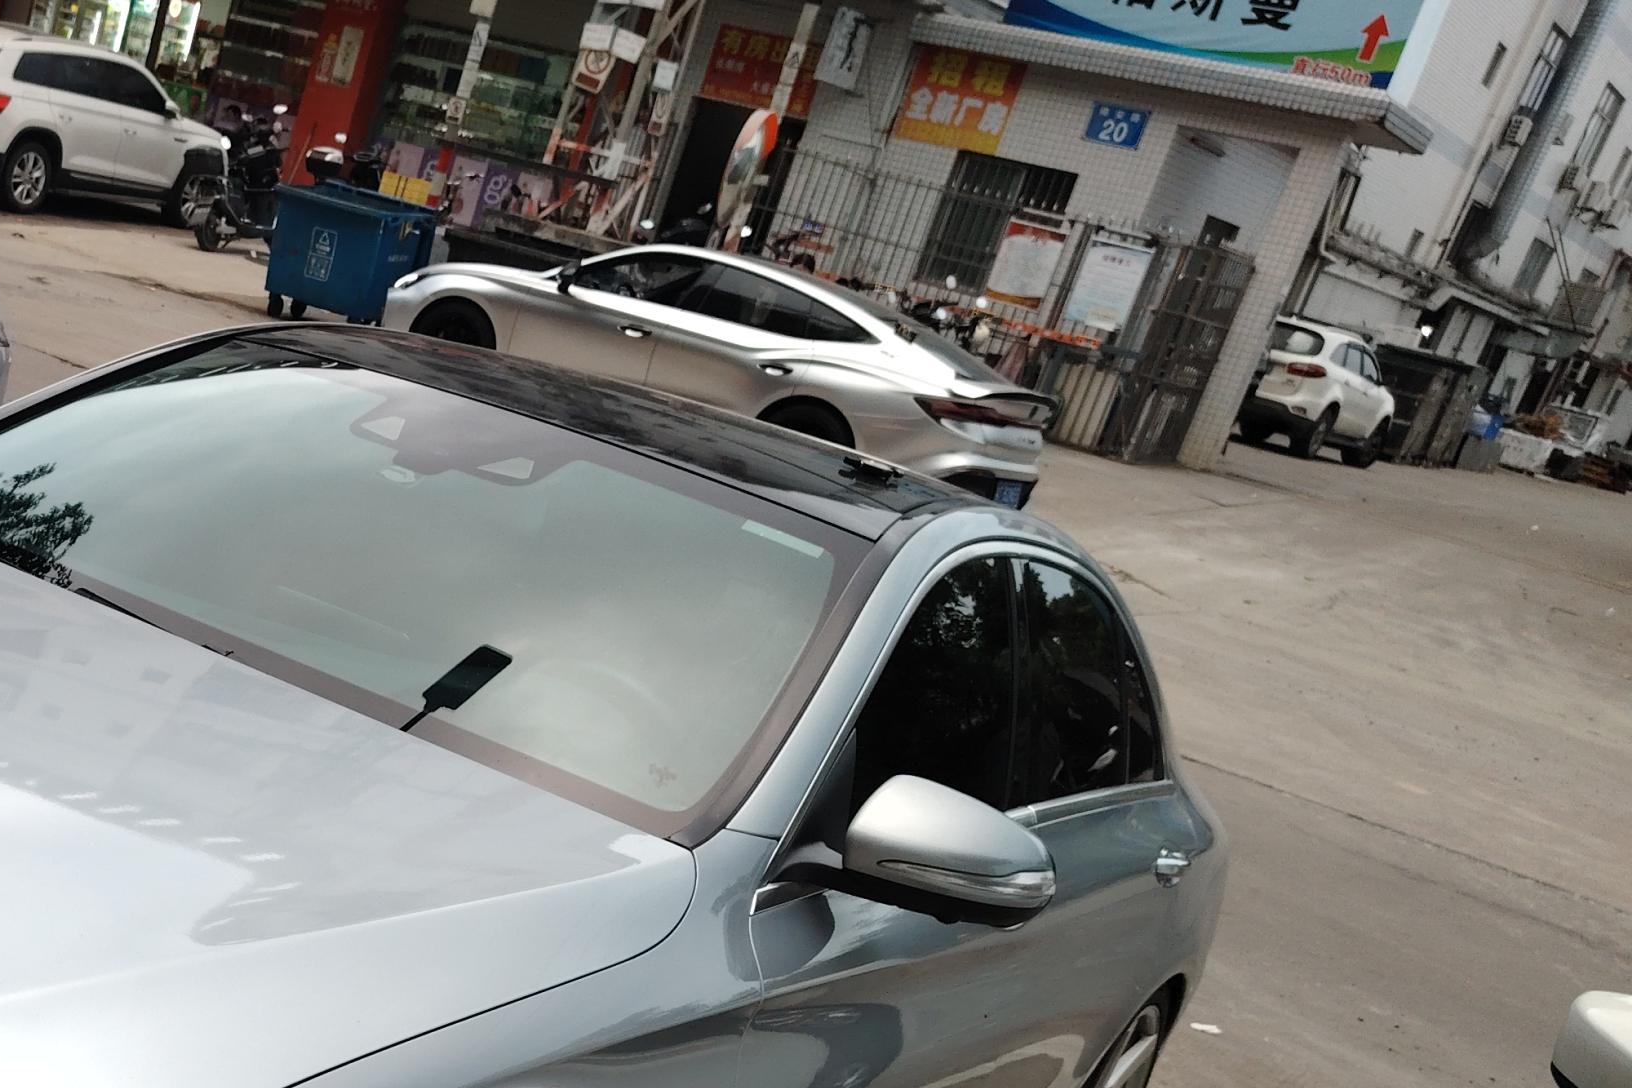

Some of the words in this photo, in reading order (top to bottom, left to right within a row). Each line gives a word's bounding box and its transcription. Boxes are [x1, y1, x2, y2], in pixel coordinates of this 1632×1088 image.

[905, 87, 1008, 135] 全新厂房
[1098, 119, 1129, 143] 20
